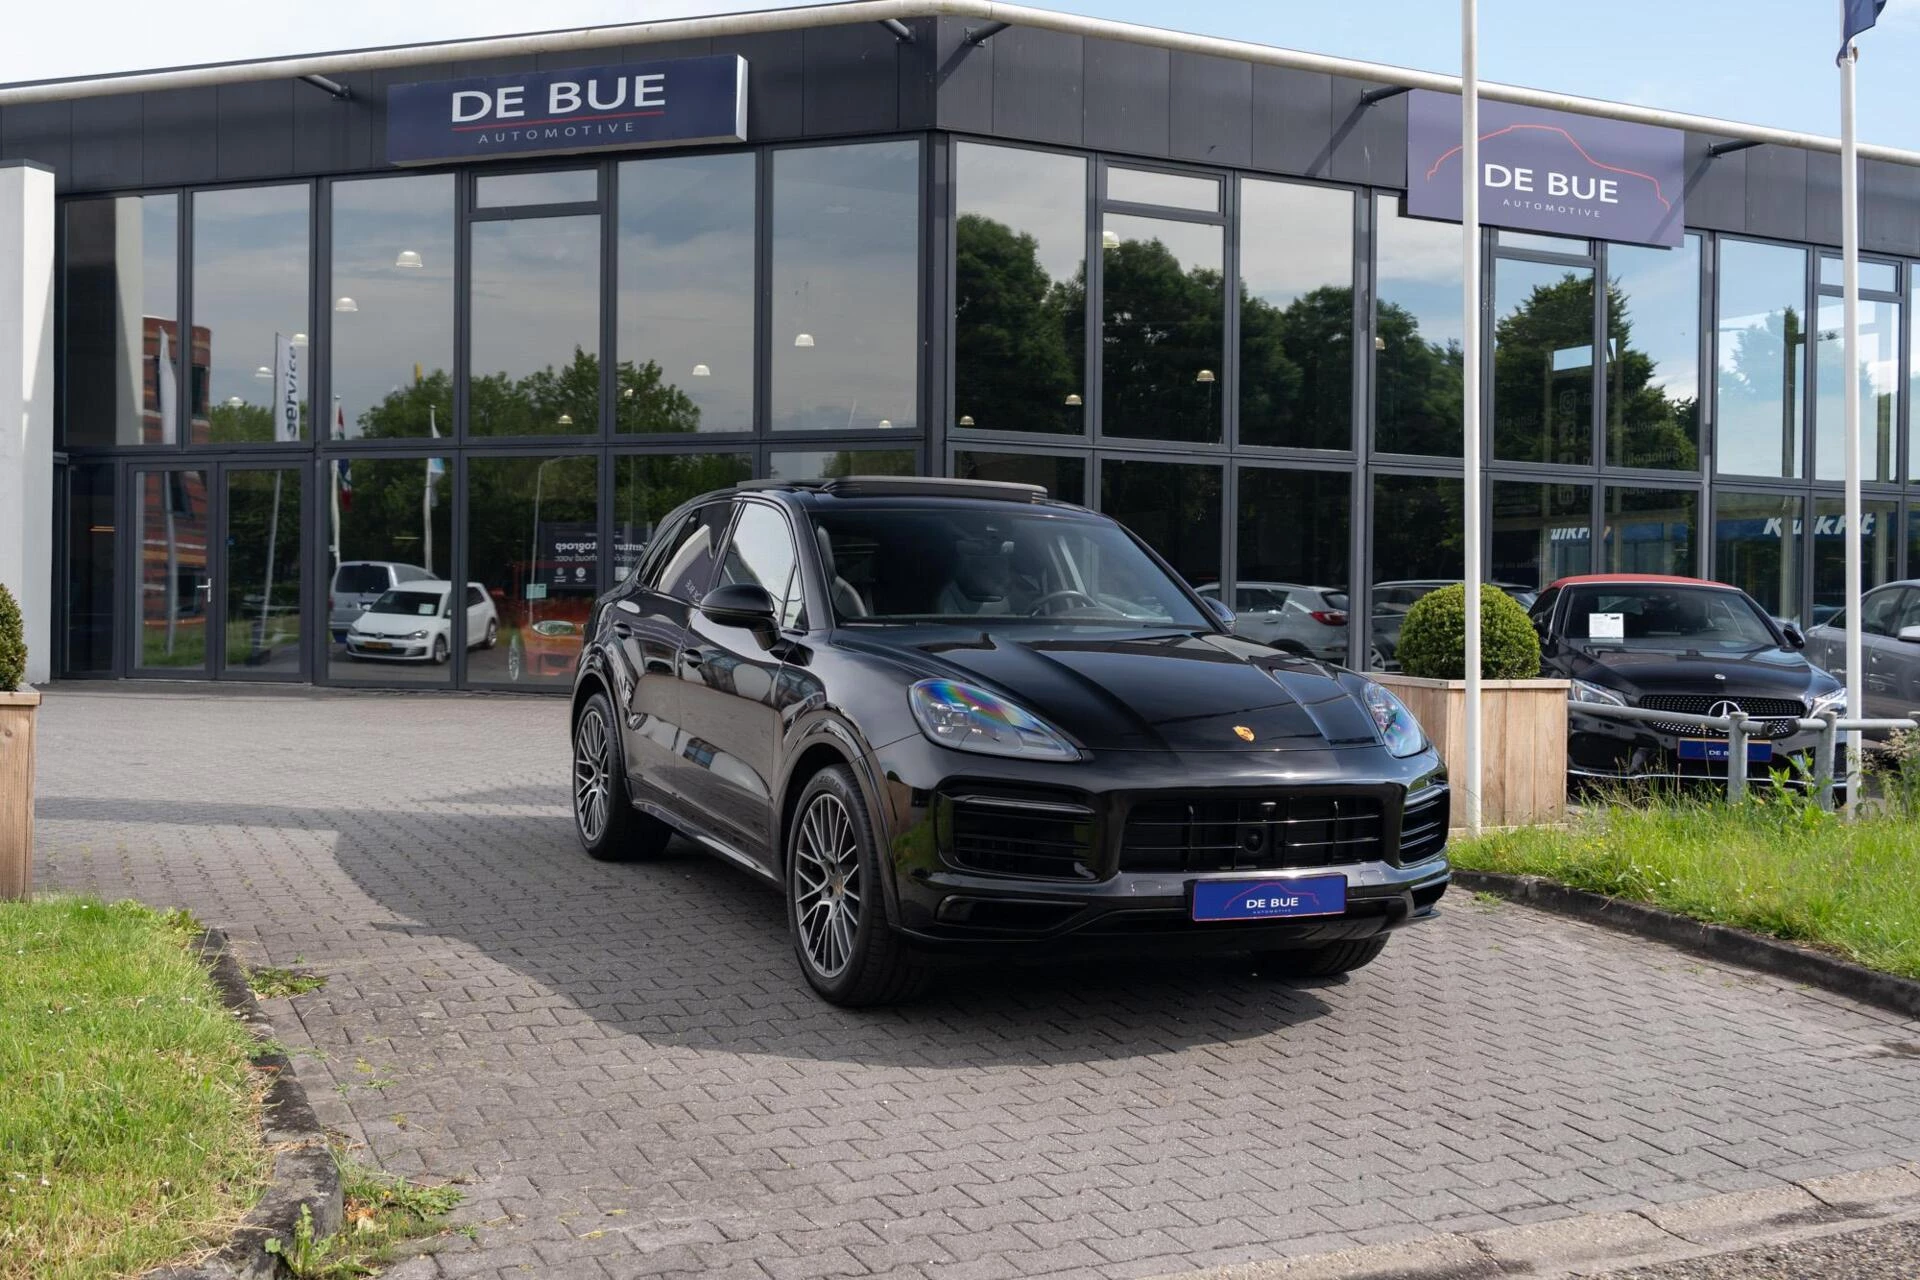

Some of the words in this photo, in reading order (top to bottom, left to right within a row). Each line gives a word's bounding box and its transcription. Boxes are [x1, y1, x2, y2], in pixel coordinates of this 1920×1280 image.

[452, 86, 525, 122] DE
[549, 74, 666, 114] BUE
[478, 122, 634, 144] AUTOMOTIVE
[1484, 163, 1533, 192] DE
[1547, 172, 1619, 204] BUE
[1503, 199, 1600, 218] AUTOMOTIVE
[1762, 513, 1876, 537] KkFt
[1246, 899, 1266, 909] DE
[1270, 897, 1299, 908] BUE
